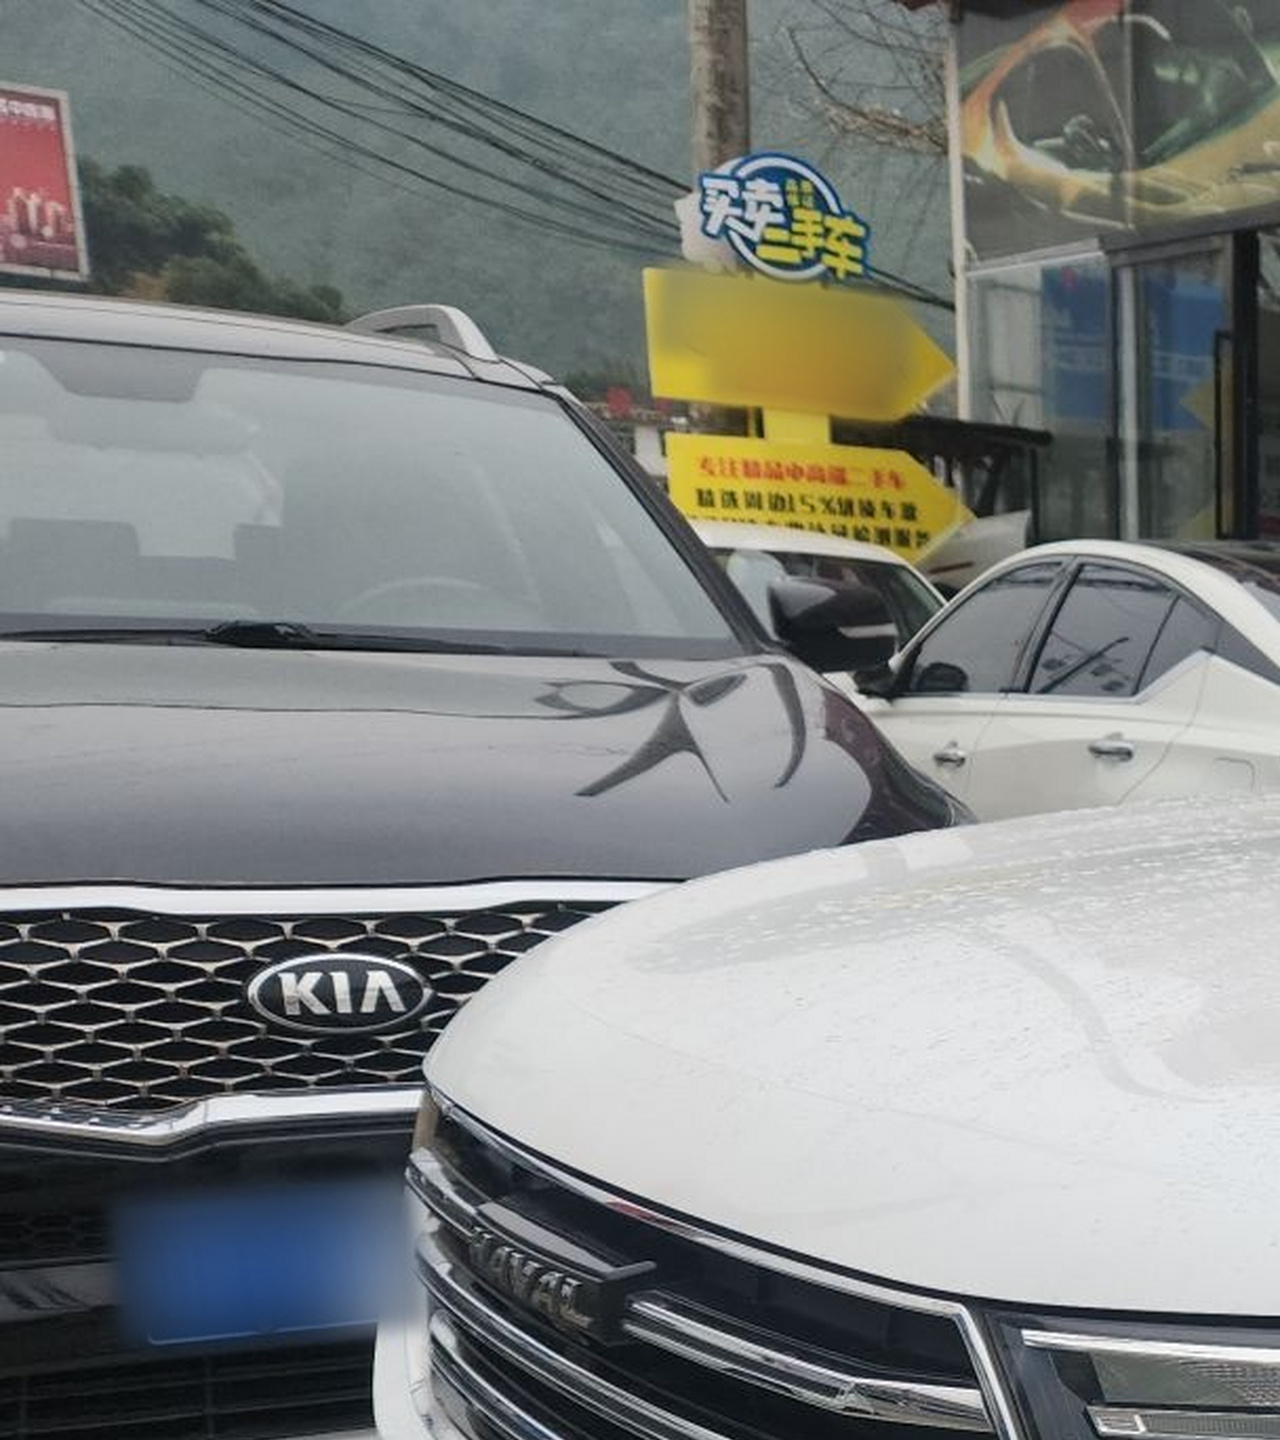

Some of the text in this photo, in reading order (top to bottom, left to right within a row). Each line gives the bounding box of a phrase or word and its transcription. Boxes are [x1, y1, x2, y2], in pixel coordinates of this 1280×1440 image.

[755, 206, 867, 280] 二手车
[277, 969, 408, 1016] KIA
